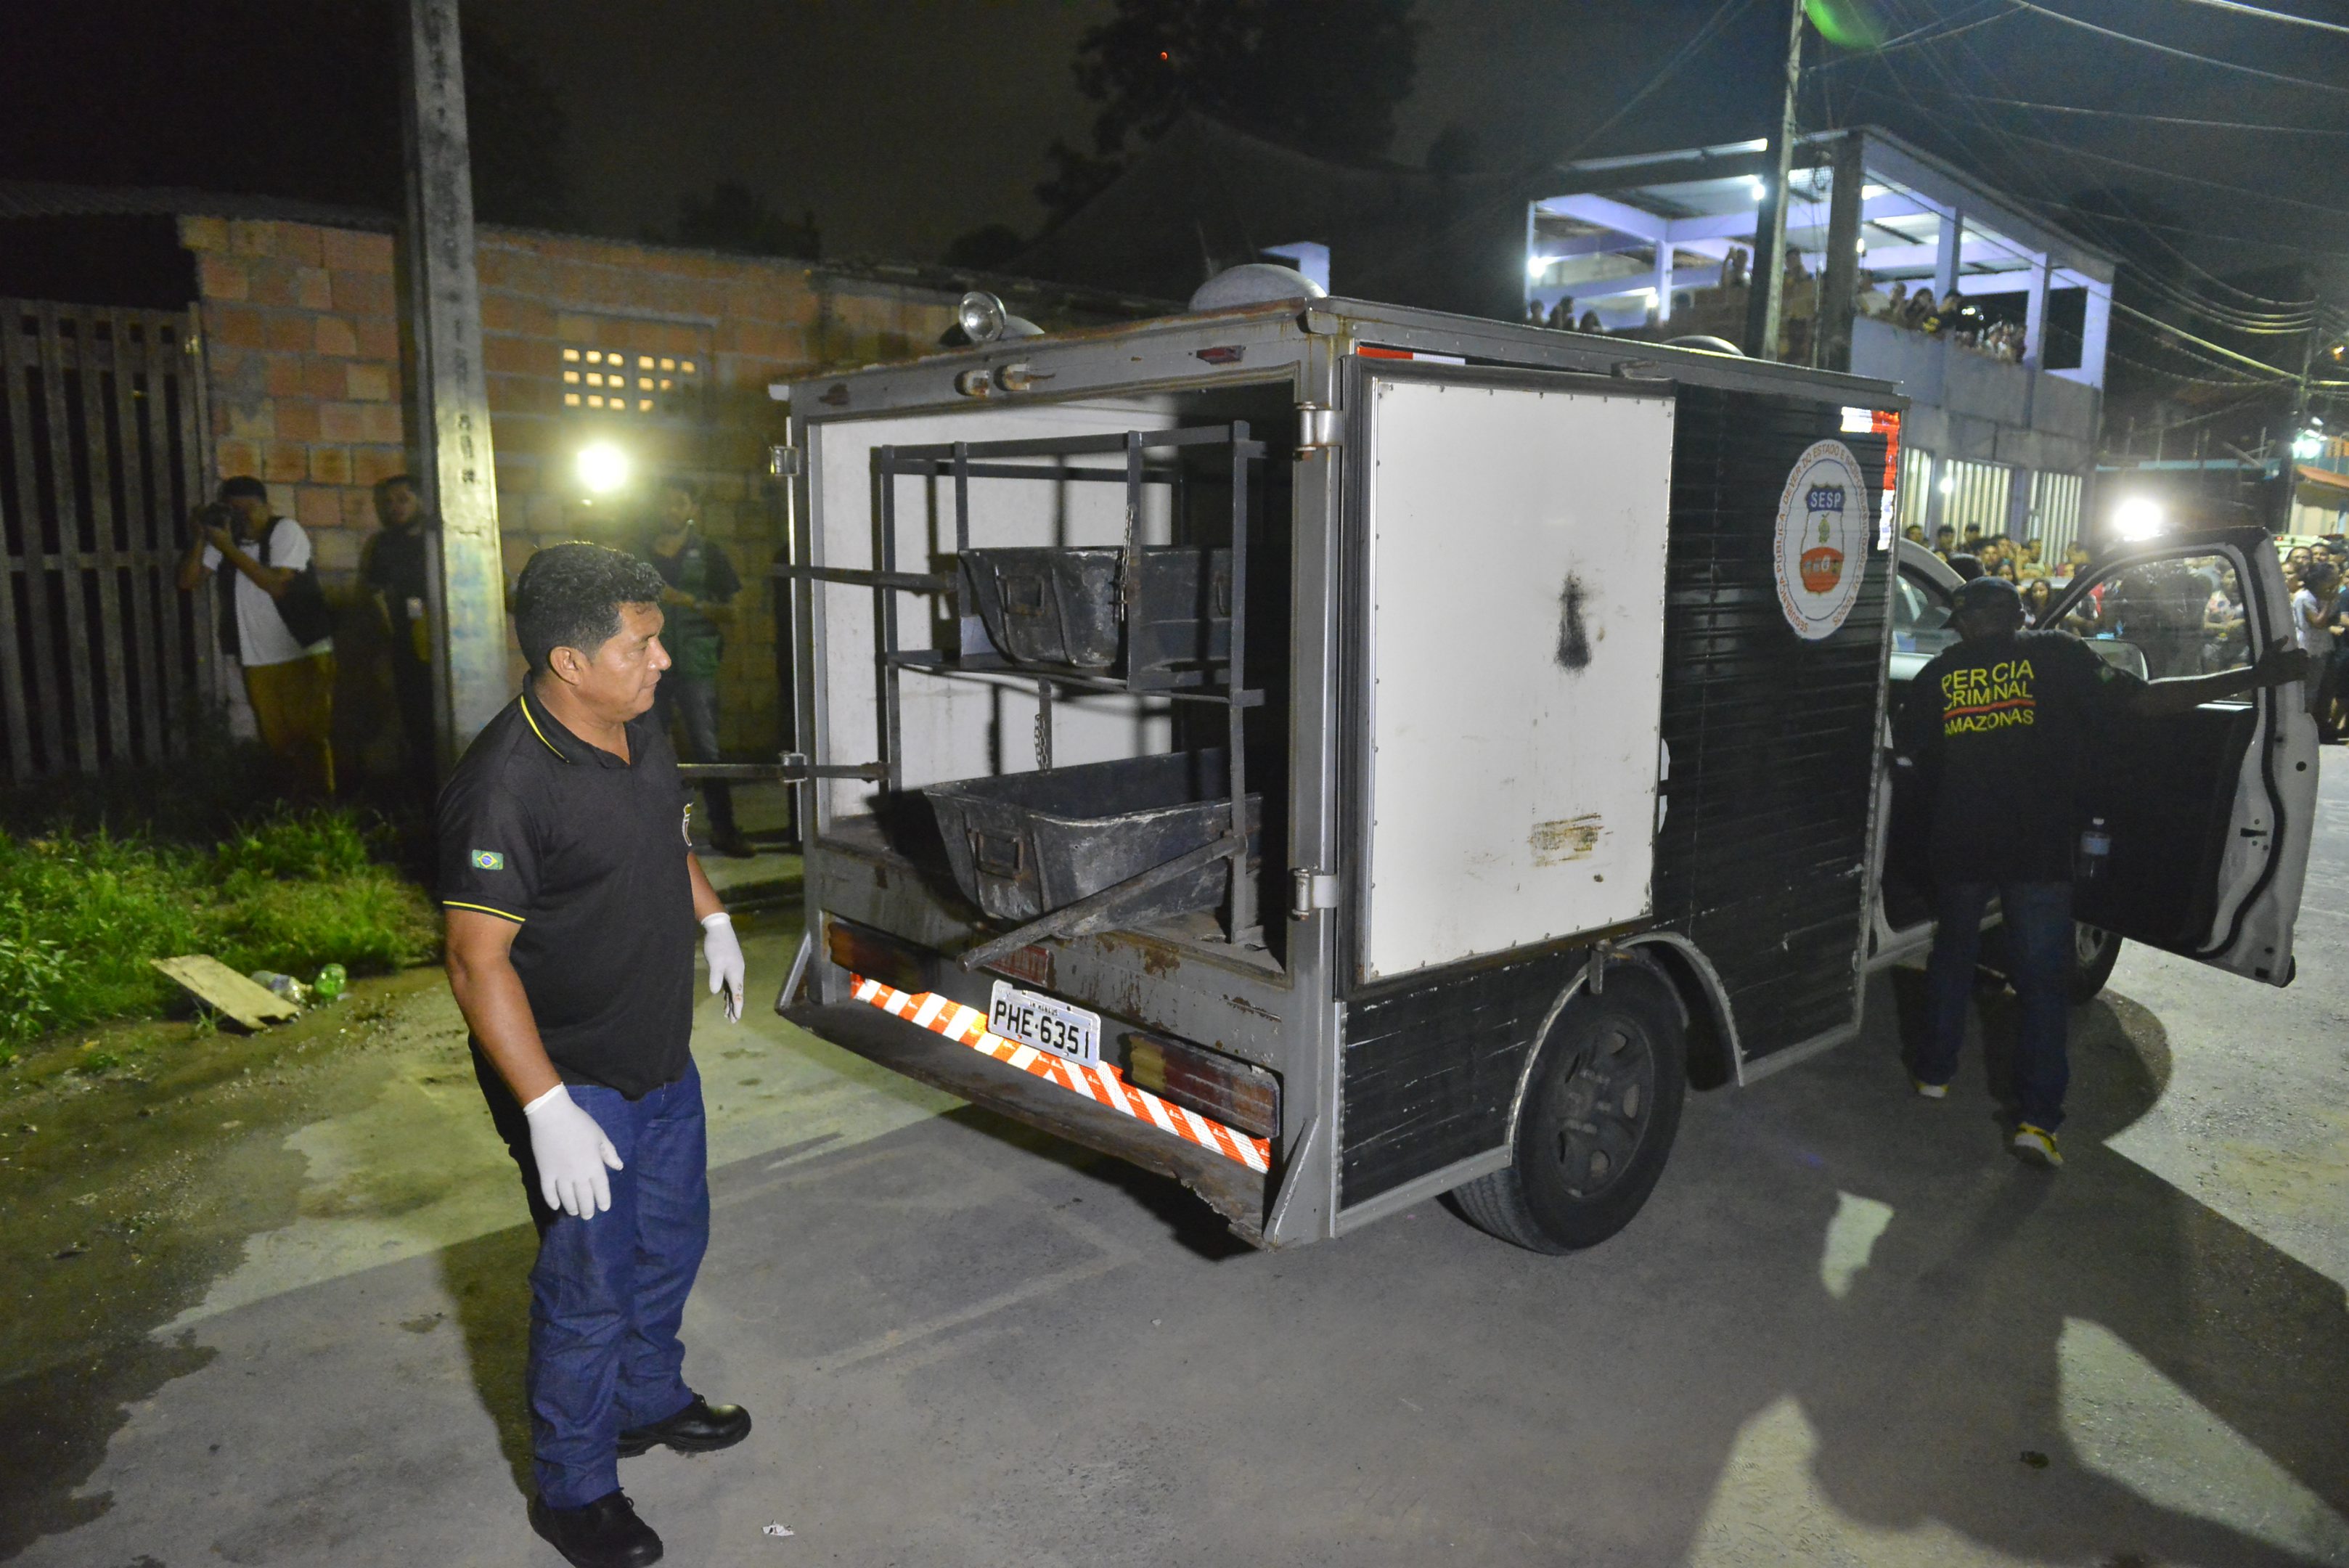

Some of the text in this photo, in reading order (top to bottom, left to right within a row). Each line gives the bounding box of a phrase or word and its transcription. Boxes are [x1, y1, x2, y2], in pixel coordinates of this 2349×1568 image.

[1813, 443, 1840, 458] ESTADO
[1810, 491, 1842, 508] SESP
[1941, 659, 2034, 693] PERCIA
[1943, 680, 2033, 711] CRIMNAL
[1945, 708, 2034, 736] AMAZONAS
